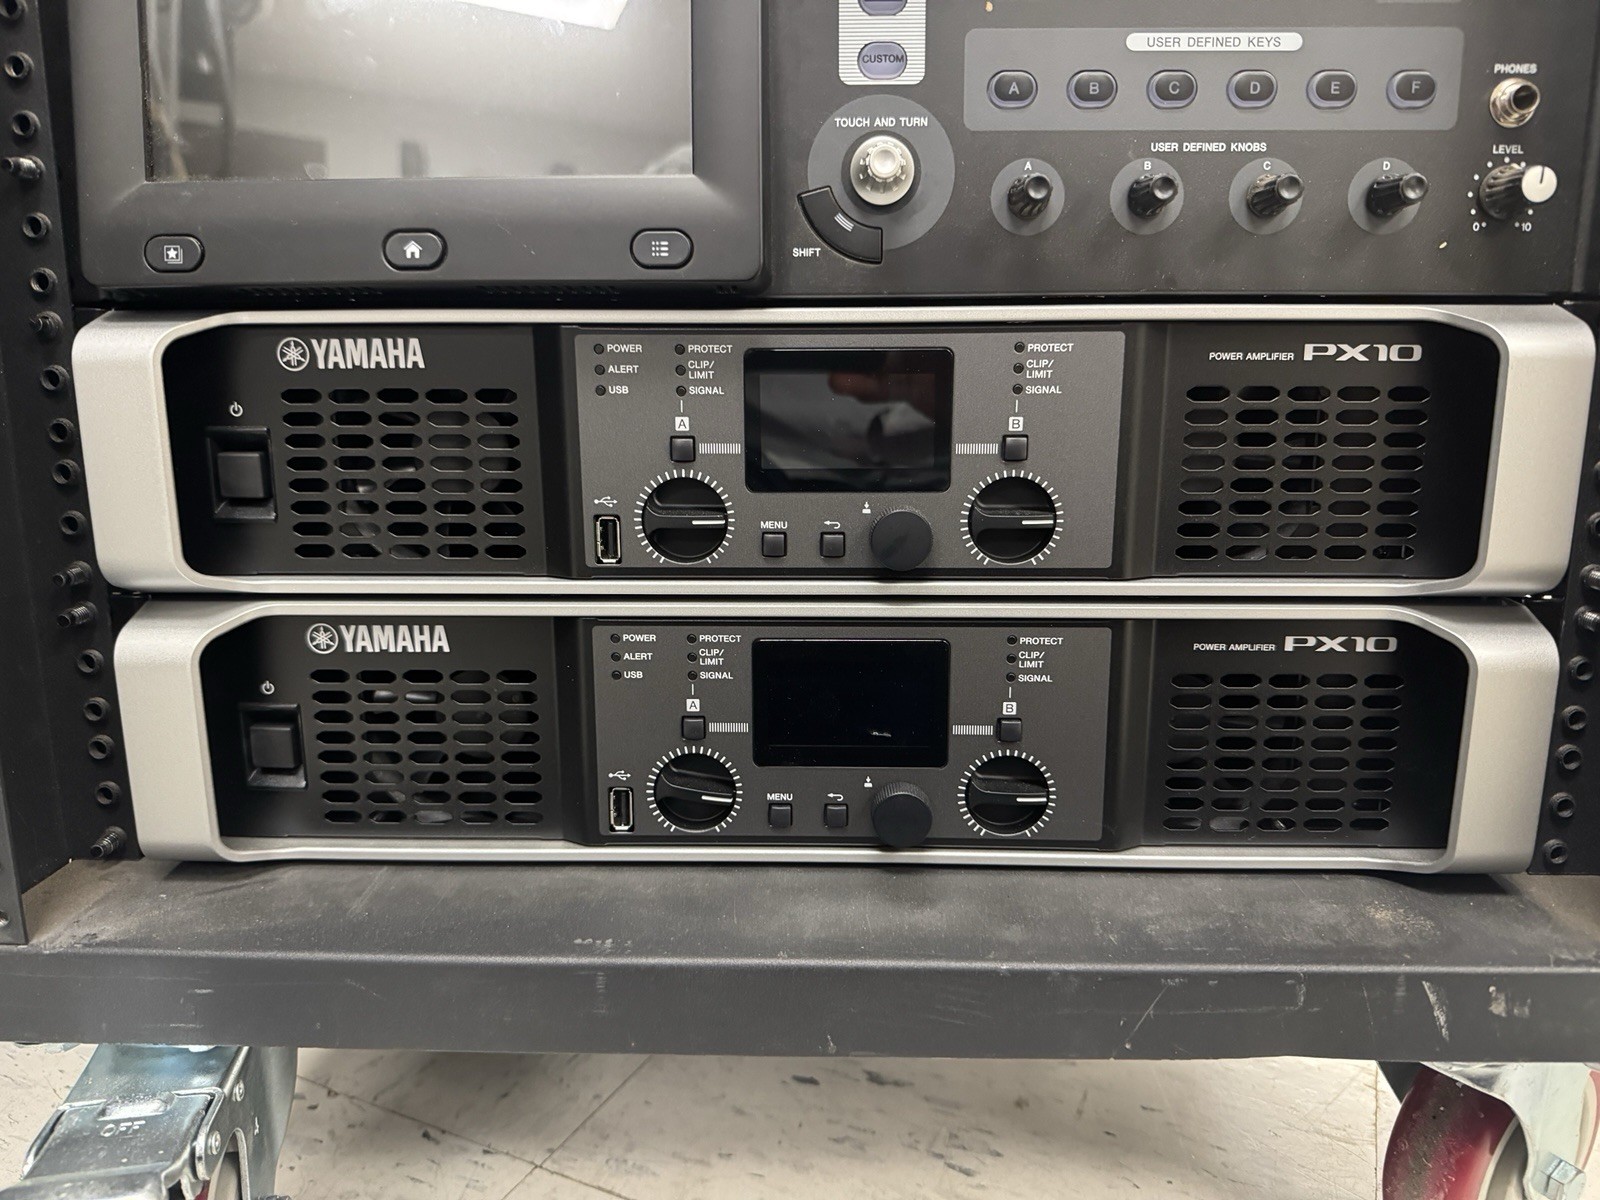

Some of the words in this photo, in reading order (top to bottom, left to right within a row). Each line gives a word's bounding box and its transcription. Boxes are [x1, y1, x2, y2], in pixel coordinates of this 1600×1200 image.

[1147, 36, 1180, 48] USER
[1188, 36, 1241, 47] DEFINED
[1247, 36, 1281, 47] KEYS
[862, 54, 904, 64] CUSTOM
[1494, 63, 1537, 74] PHONES
[1009, 82, 1020, 94] A
[1089, 82, 1099, 94] B
[1169, 82, 1180, 94] C
[1250, 82, 1260, 94] D
[1331, 82, 1340, 94] E
[1412, 81, 1421, 94] F
[835, 118, 870, 127] TOUCH
[874, 118, 895, 127] AND
[899, 117, 928, 127] TURN
[1151, 142, 1178, 152] USER
[1183, 142, 1226, 152] DEFINED
[1231, 142, 1267, 152] KNOBS
[1492, 145, 1523, 155] LEVEL
[1024, 162, 1032, 170] A
[1144, 162, 1151, 170] B
[1263, 161, 1271, 171] C
[1383, 161, 1391, 171] D
[1472, 222, 1480, 231] 0
[1521, 222, 1532, 231] 10
[792, 248, 821, 257] SHIFT
[688, 345, 732, 353] PROTECT
[1027, 344, 1074, 352] PROTECT
[1209, 352, 1243, 360] POWER
[1246, 353, 1294, 361] AMPLIFIER
[1304, 343, 1422, 362] PX10
[310, 338, 425, 369] YAMAHA
[688, 361, 714, 369] CLIP/
[1026, 360, 1054, 368] CLIP/
[608, 365, 639, 373] ALERT
[689, 371, 714, 379] LIMIT
[1026, 370, 1053, 378] LIMIT
[609, 386, 629, 394] USB
[689, 387, 724, 395] SIGNAL
[1025, 386, 1062, 394] SIGNAL
[678, 419, 687, 429] A
[1012, 419, 1020, 429] B
[760, 521, 788, 529] MENU
[339, 625, 450, 652] YAMAHA
[1020, 637, 1063, 645] PROTECT
[1284, 636, 1397, 652] PX10
[1019, 651, 1045, 659] CLIP/
[700, 658, 724, 666] LIMIT
[689, 701, 697, 710] A
[1006, 704, 1014, 712] B
[100, 1120, 146, 1138] OFF
